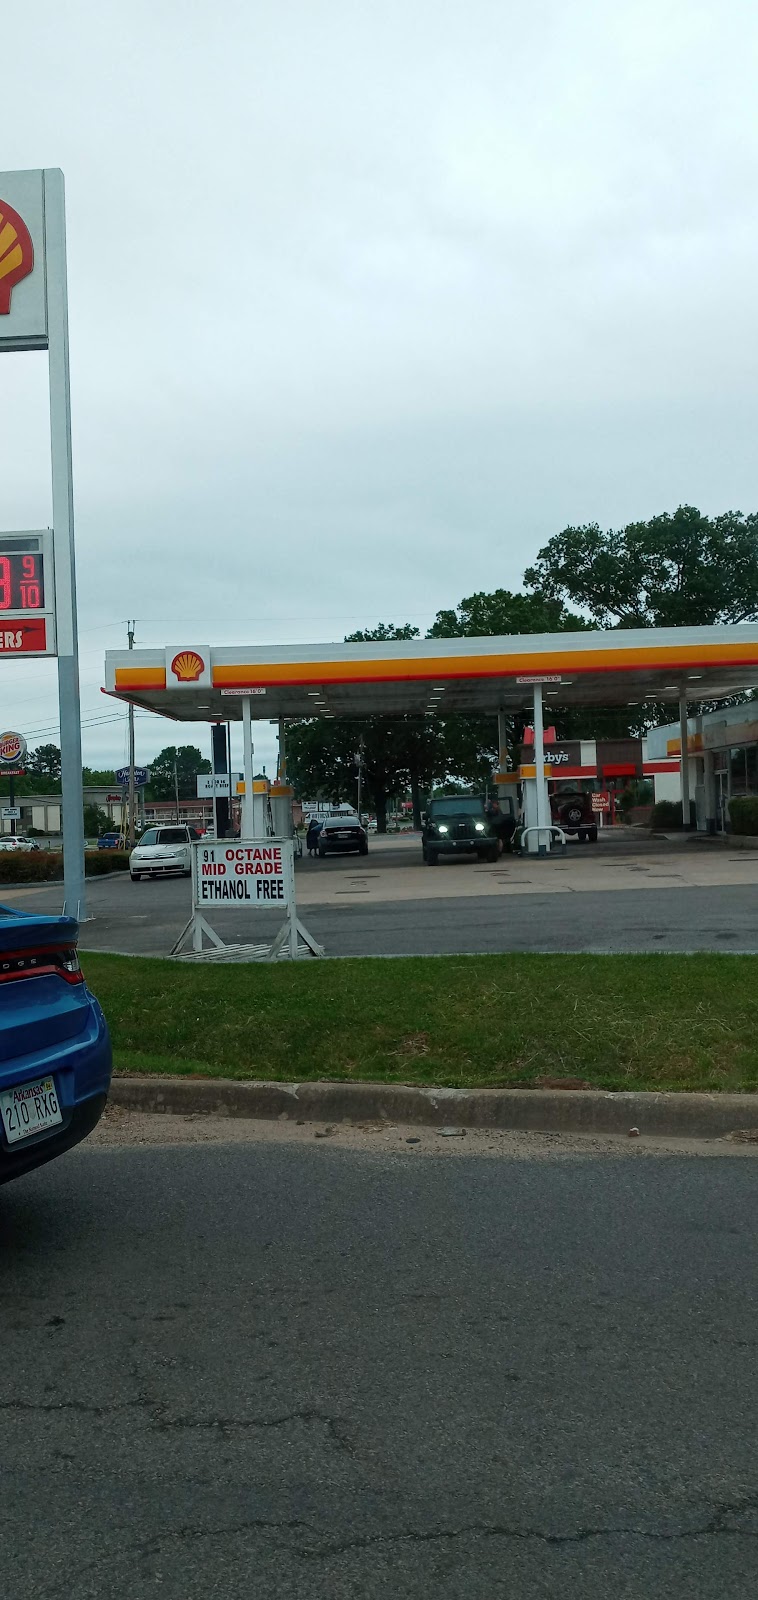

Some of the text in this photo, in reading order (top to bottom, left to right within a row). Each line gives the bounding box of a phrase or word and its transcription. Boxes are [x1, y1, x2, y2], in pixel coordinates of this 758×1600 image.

[22, 555, 35, 578] 9
[20, 585, 40, 609] 10
[0, 743, 20, 756] KING
[533, 750, 569, 764] rby's
[203, 847, 282, 863] 91 OCTANE
[202, 861, 283, 876] MID GRADE
[201, 879, 284, 900] ETHANOL FREE
[13, 1084, 44, 1104] Arkansas
[5, 1092, 58, 1132] 210 RXG
